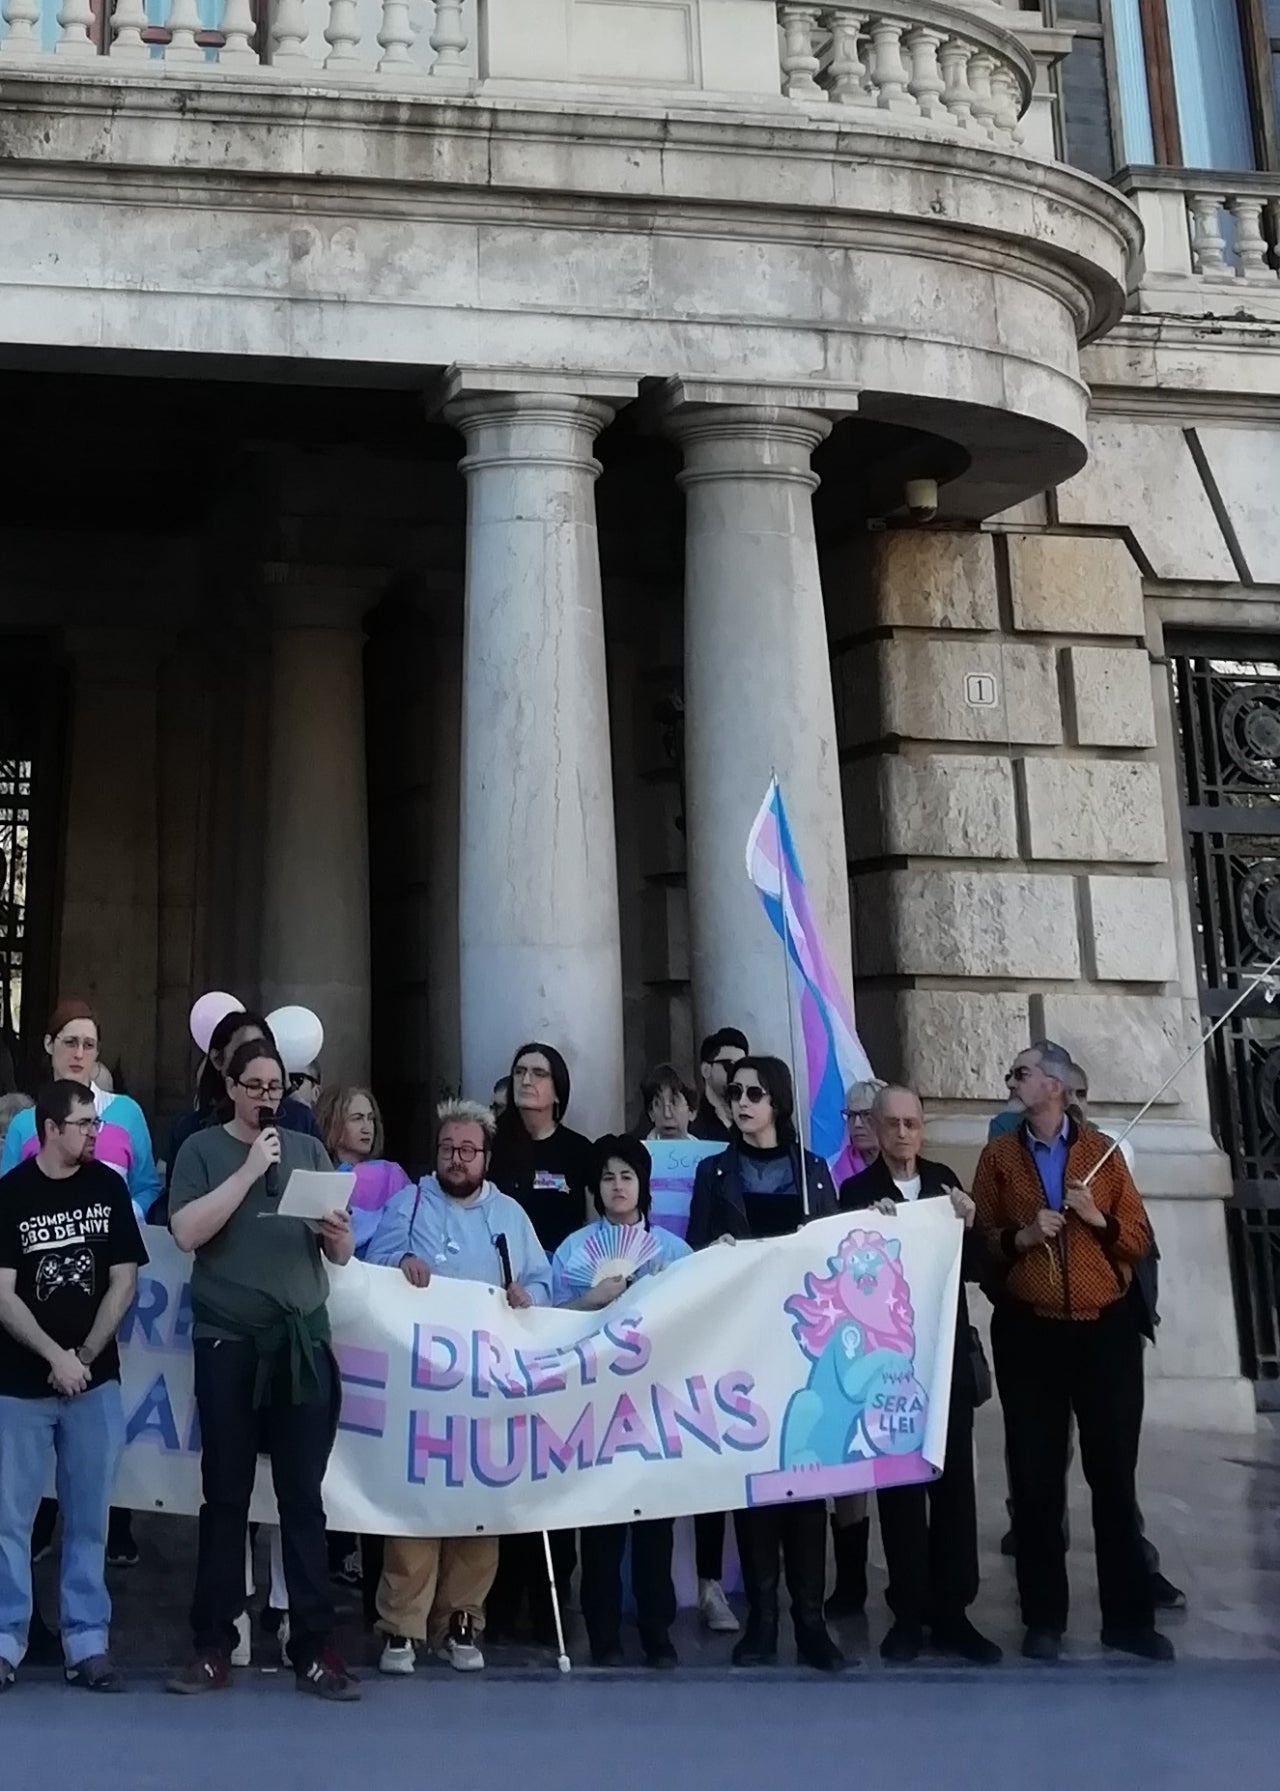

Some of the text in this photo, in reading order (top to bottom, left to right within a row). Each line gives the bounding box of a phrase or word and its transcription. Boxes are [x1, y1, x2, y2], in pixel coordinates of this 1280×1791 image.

[975, 679, 985, 701] 1
[86, 1203, 112, 1219] AÑO
[21, 1219, 109, 1247] UBO DE NIVE
[411, 1316, 652, 1399] DRETS
[407, 1370, 770, 1488] HUMANS
[879, 1413, 915, 1434] LLEI
